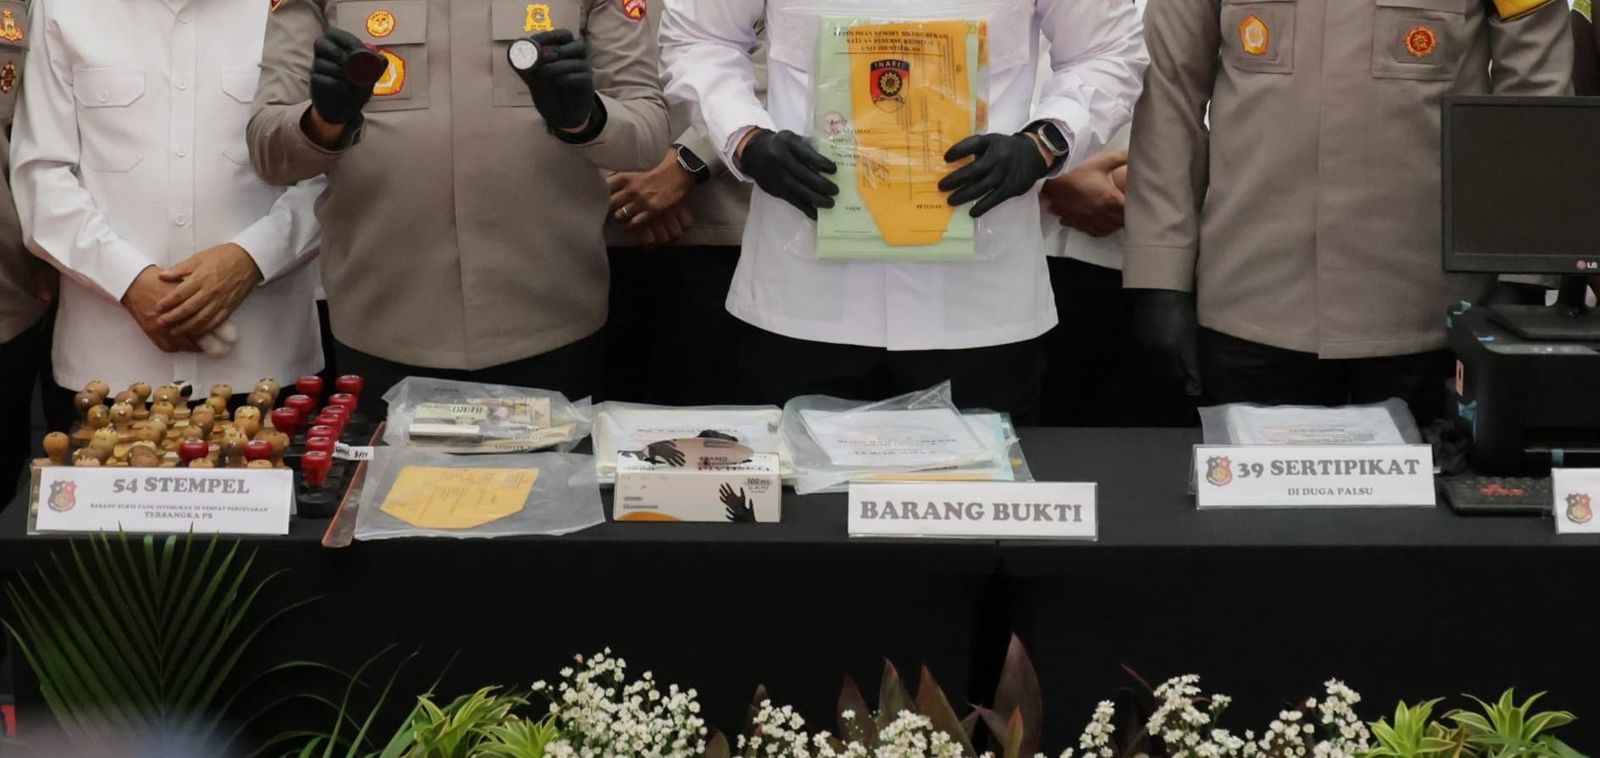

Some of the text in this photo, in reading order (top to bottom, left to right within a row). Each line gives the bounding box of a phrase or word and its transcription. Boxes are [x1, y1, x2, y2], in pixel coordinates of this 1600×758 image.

[1587, 261, 1598, 269] LG
[1237, 459, 1420, 478] 39 SERTIPIKAT
[112, 477, 250, 494] 54 STEMPEL
[1288, 487, 1374, 496] DI DUGA PALSU
[144, 511, 200, 519] TERSANGKA
[860, 500, 1083, 522] BARANG BUKTI
